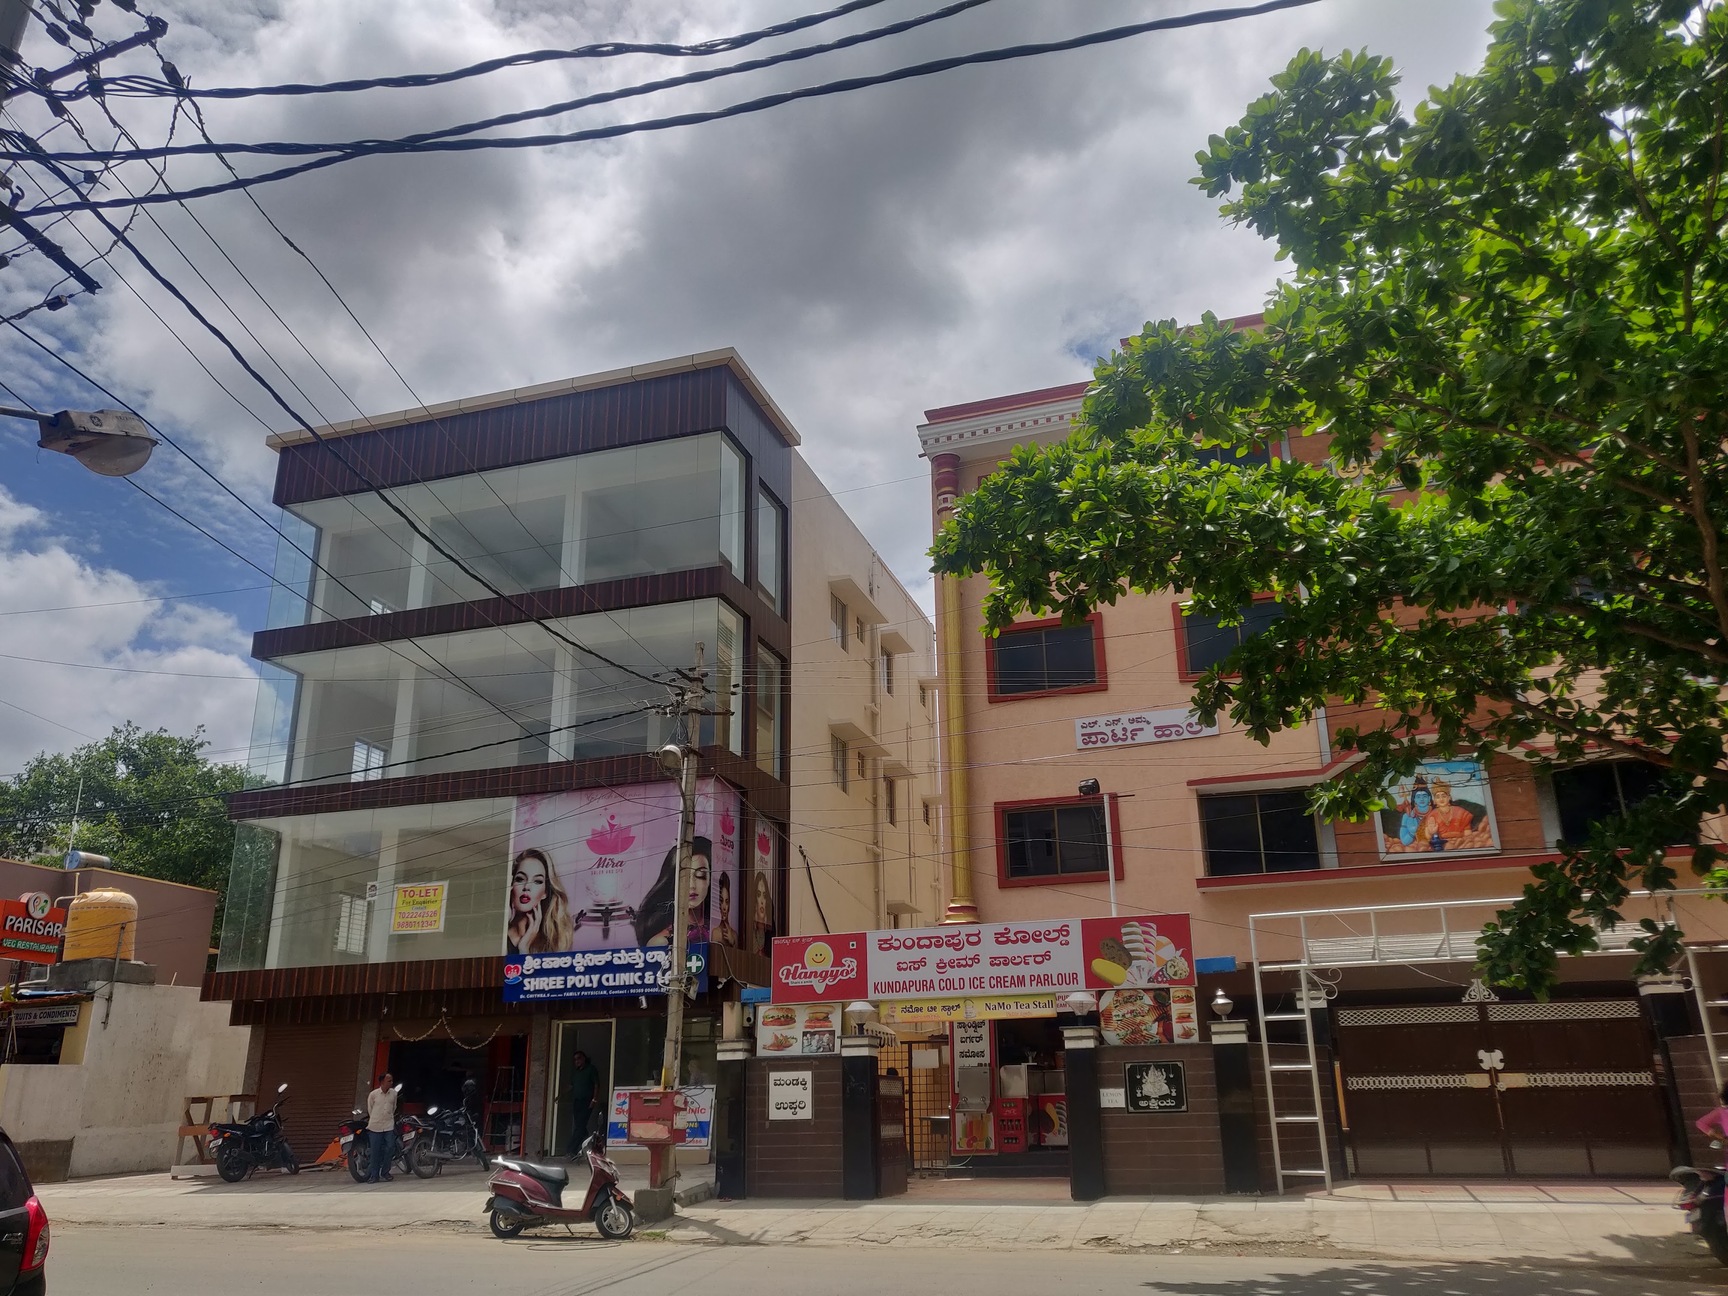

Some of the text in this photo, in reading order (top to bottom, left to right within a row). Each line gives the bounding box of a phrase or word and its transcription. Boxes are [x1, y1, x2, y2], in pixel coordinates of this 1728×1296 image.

[589, 857, 625, 869] Mira
[402, 888, 439, 898] TO-LET
[5, 915, 63, 937] PARISAR
[3, 938, 59, 953] VEG RESTAURANT
[878, 924, 1071, 952] ಕುಂದಾಪುರ ಕೋಲ್ಡ್
[522, 955, 541, 975] ಶ್ರೀ
[897, 950, 1052, 974] ಐಸ್ ಕ್ರೀಮ್ ಪಾರ್ಲರ್
[523, 976, 565, 991] SHREE
[566, 974, 601, 988] POLY
[601, 972, 643, 987] CLINIC
[644, 971, 655, 984] &
[780, 965, 855, 984] Hangyo
[873, 972, 1079, 994] KUNDAPURA COLD ICE CREAM PARLOUR
[39, 1010, 77, 1019] CONDIMENTS
[985, 999, 1054, 1011] NaMo Tea Stall
